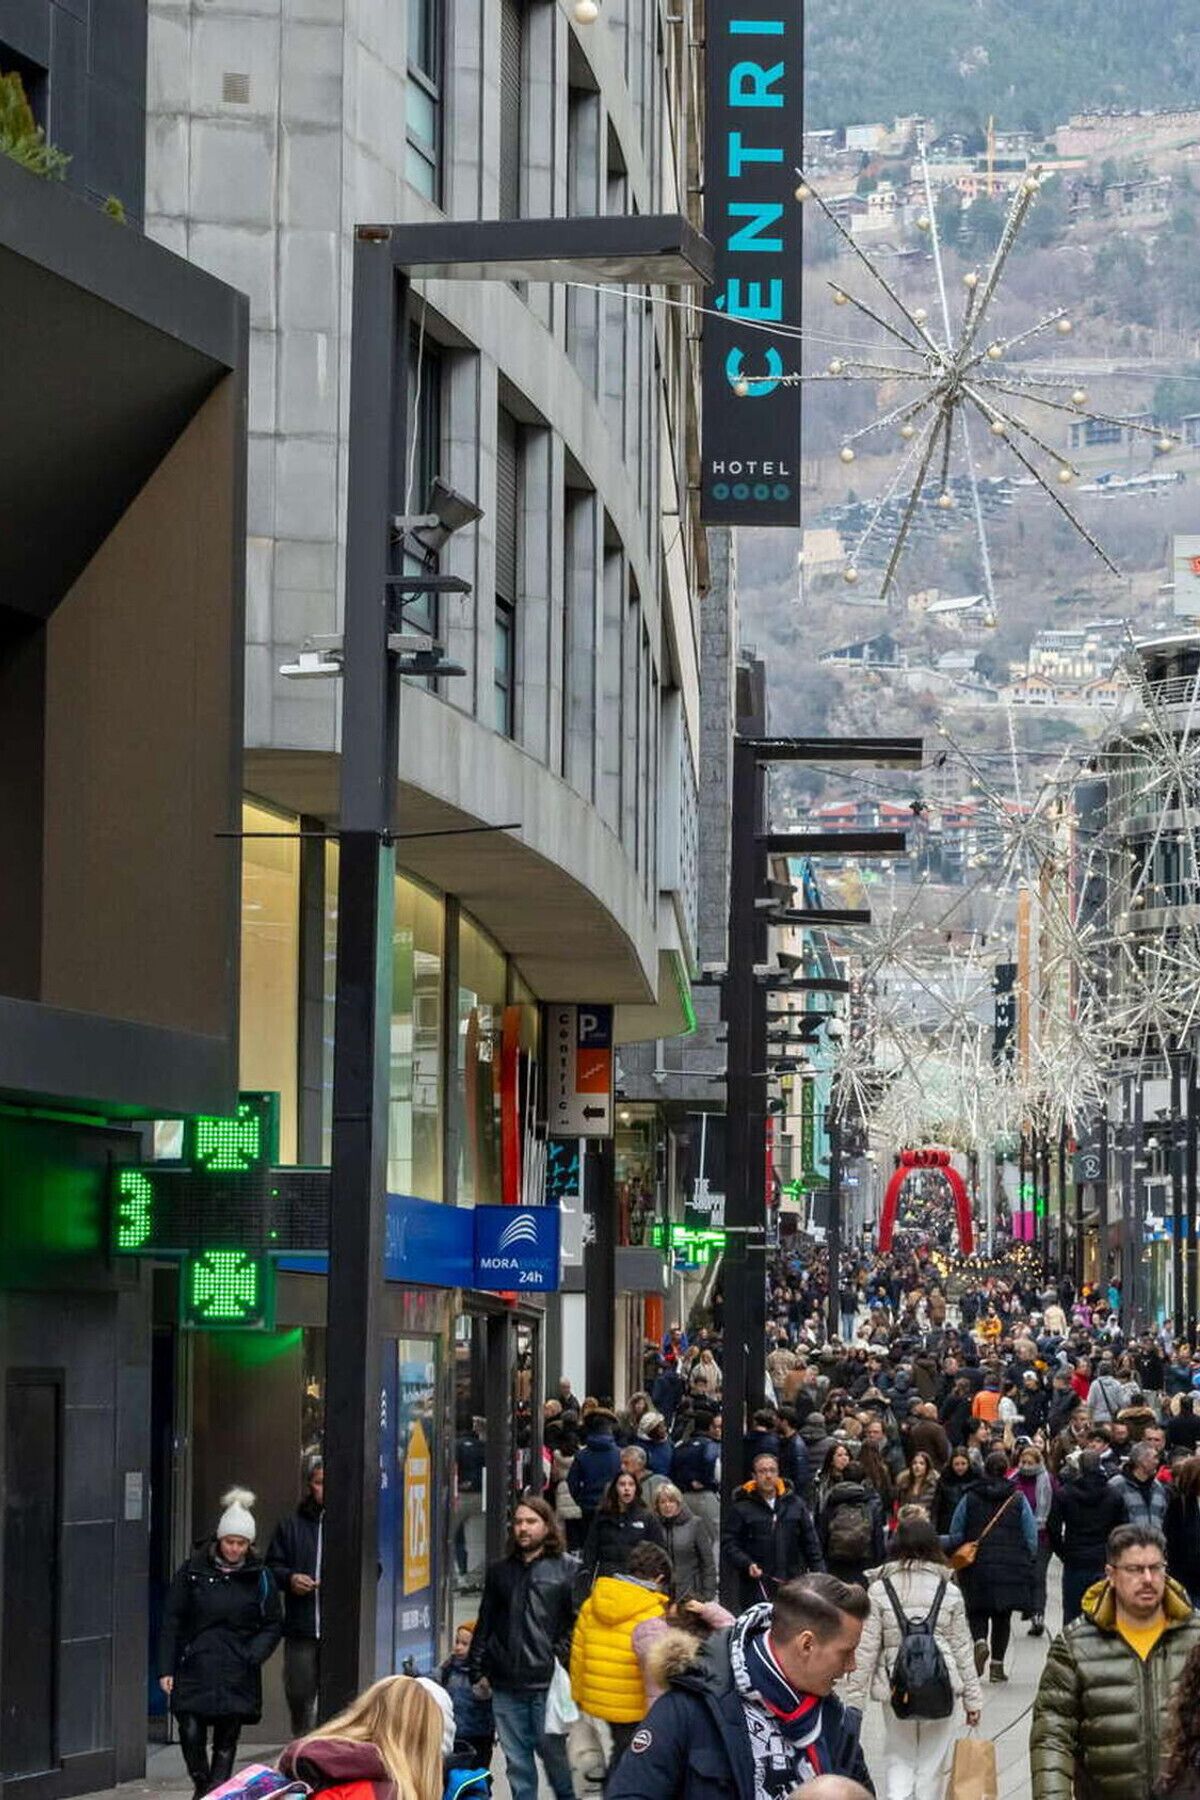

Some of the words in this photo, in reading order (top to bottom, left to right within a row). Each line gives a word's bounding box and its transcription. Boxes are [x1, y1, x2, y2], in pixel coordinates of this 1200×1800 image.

[713, 461, 789, 475] HOTEL
[579, 1013, 598, 1041] P
[519, 1271, 543, 1283] 24h
